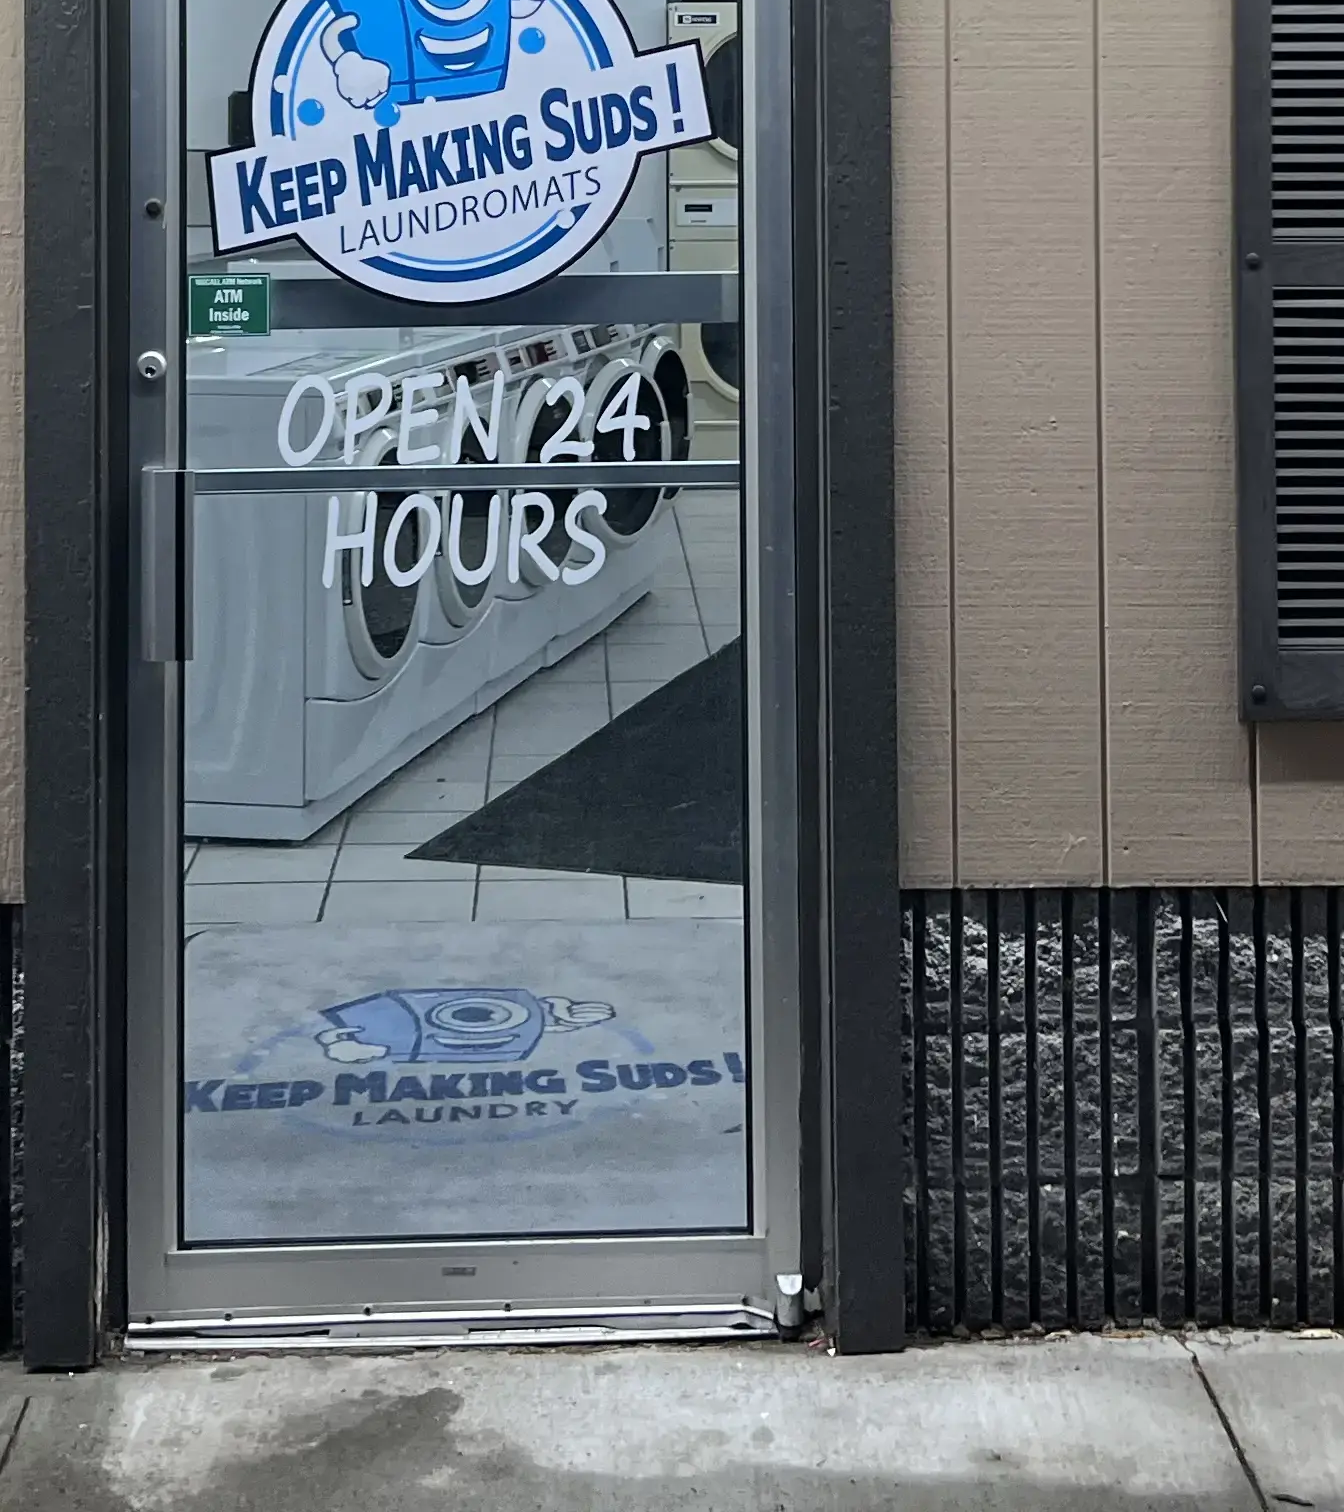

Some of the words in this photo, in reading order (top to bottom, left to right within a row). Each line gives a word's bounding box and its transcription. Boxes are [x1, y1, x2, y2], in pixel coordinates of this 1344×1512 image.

[236, 155, 348, 235] KEEP
[354, 114, 533, 207] MAKING
[340, 165, 602, 255] LAUNDROMATS
[209, 307, 250, 322] Inside
[214, 288, 243, 304] ATM
[277, 370, 504, 466] OPEN
[539, 372, 651, 464] 24
[321, 490, 608, 589] HOURS
[183, 1078, 325, 1114] KEEP
[333, 1069, 568, 1107] MAKING
[352, 1098, 581, 1127] LAUNDRY
